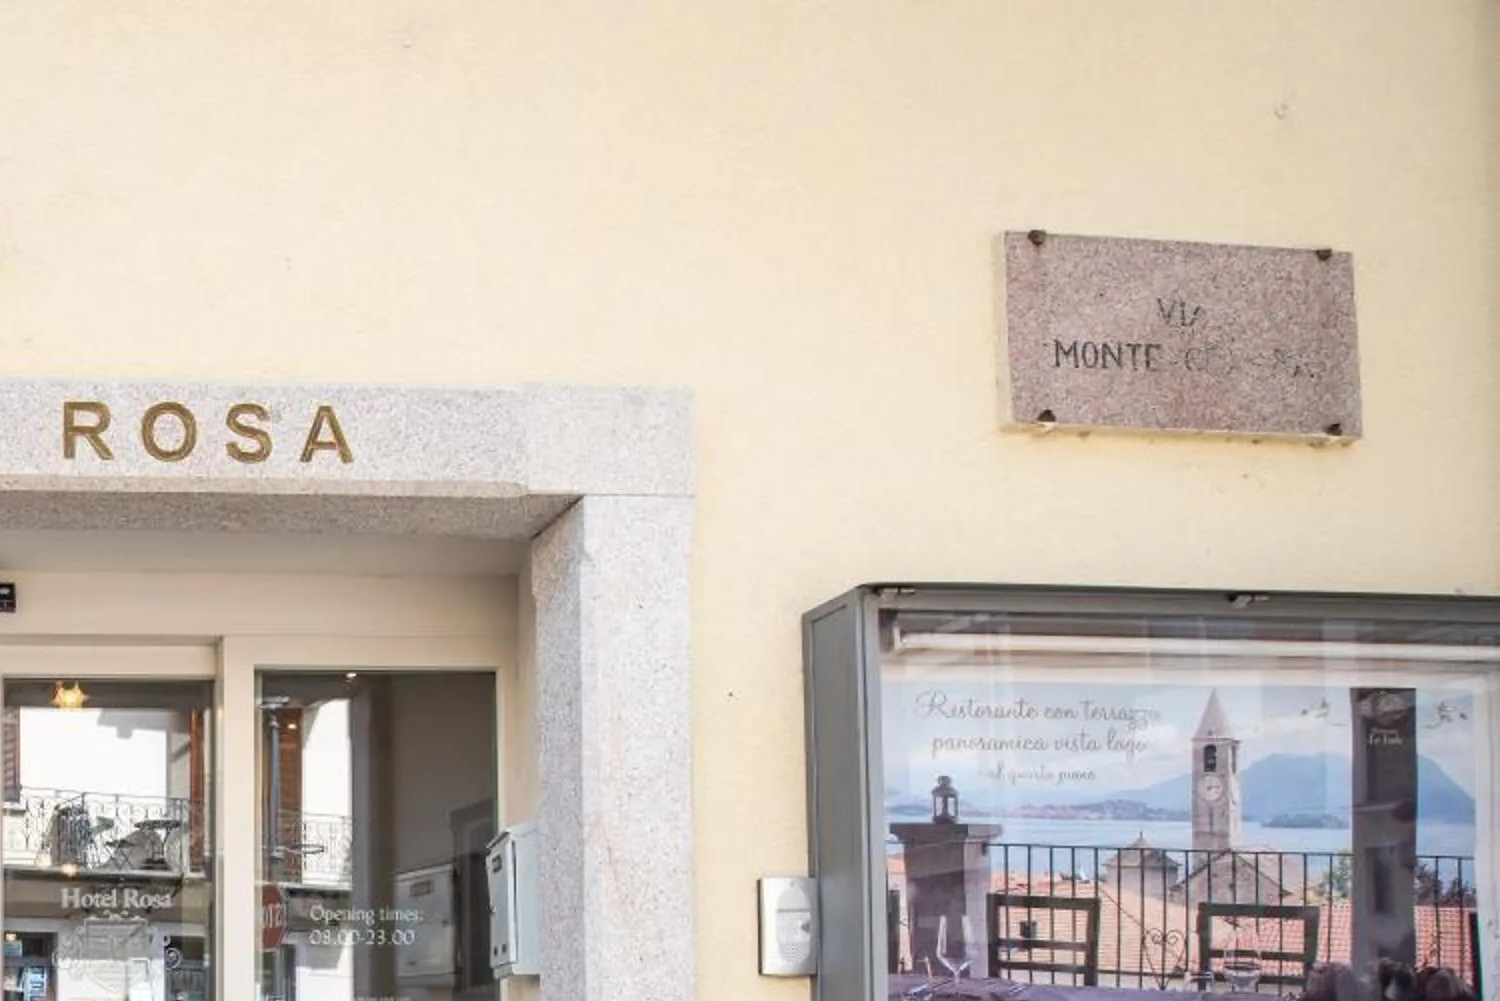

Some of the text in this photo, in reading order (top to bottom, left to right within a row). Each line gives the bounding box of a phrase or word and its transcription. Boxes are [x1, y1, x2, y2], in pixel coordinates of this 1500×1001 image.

[1053, 339, 1161, 372] MONTE
[62, 401, 355, 463] ROSA
[915, 687, 1039, 719] Ristorante
[1043, 707, 1078, 720] con
[931, 728, 1148, 763] panoramica vista lago
[61, 888, 175, 909] Hotel Rosa
[308, 904, 424, 926] Opening times:
